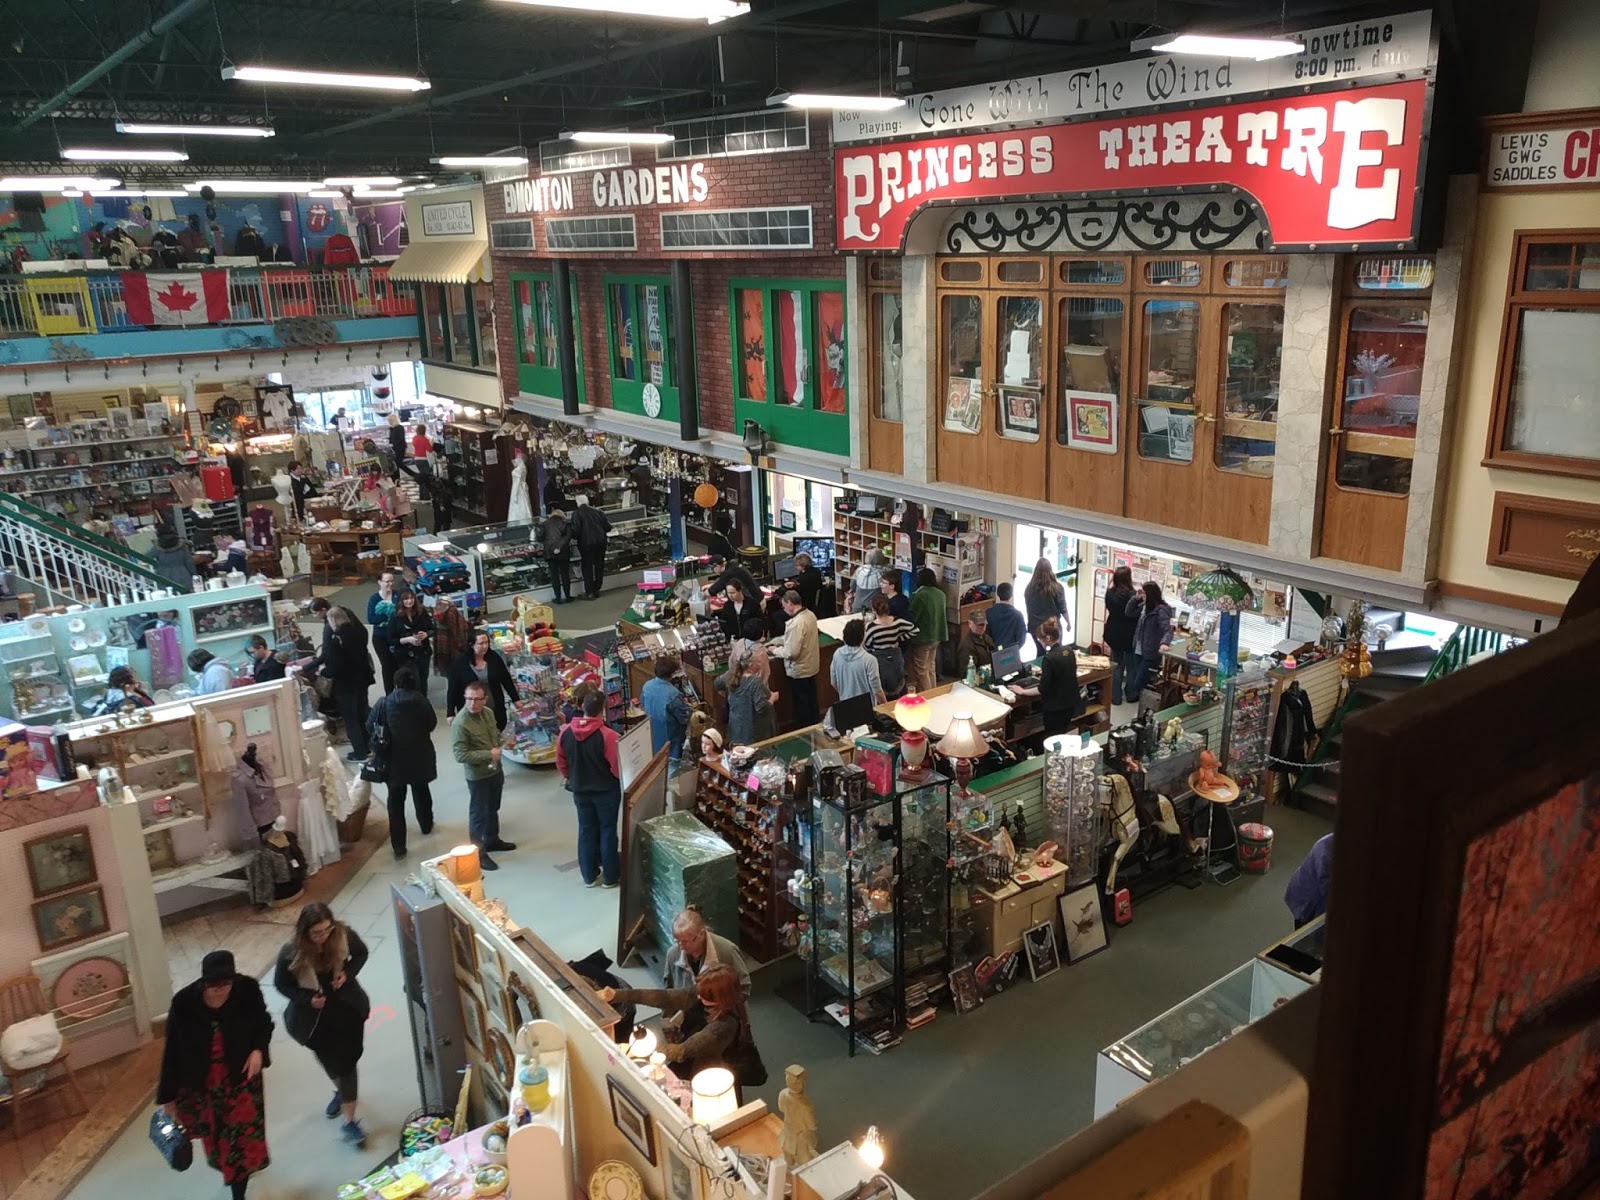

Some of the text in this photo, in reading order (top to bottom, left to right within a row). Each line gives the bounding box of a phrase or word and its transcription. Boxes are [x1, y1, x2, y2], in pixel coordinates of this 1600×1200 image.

[1298, 24, 1394, 57] howtime
[1295, 57, 1329, 79] 8:00
[1333, 56, 1361, 78] pm.
[907, 57, 1233, 129] "Gone With The Wind
[838, 111, 861, 123] Now
[858, 121, 902, 135] Playing:
[1501, 133, 1549, 150] LEVI'S
[1508, 149, 1542, 164] GWG
[843, 98, 1407, 243] PRINCESS THEATRE
[1492, 165, 1557, 182] SADDLES
[504, 162, 709, 214] EDMONTON GARDENS
[978, 516, 994, 534] EXIT
